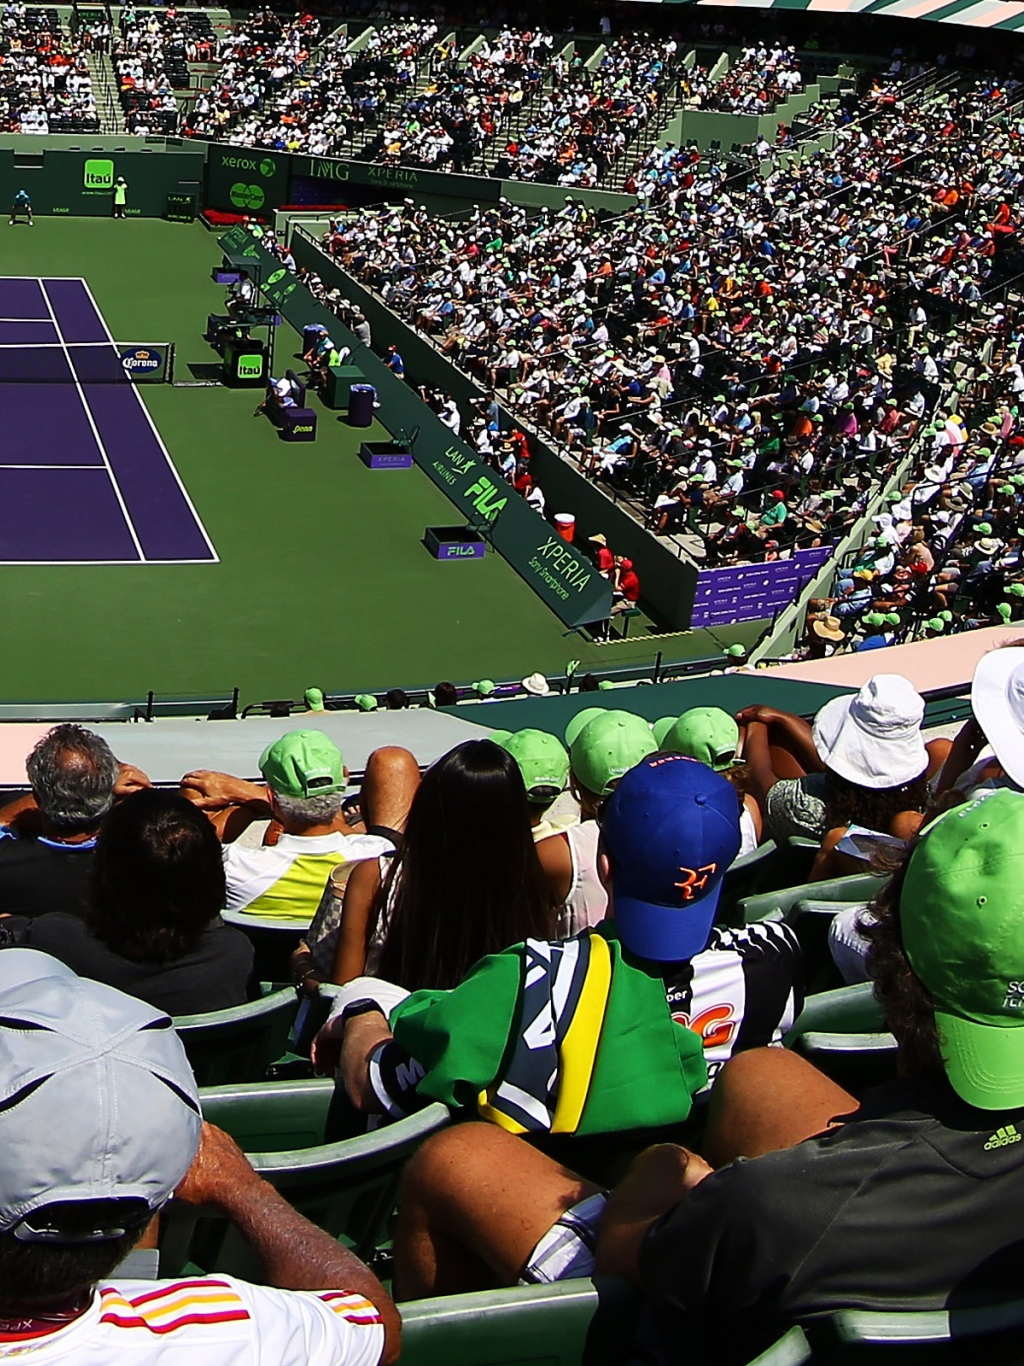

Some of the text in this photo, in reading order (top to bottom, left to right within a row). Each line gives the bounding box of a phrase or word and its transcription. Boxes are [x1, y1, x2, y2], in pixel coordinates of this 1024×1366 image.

[221, 155, 256, 170] xerox
[309, 159, 350, 181] IMG
[86, 172, 112, 184] Itaú
[367, 166, 418, 182] XPERIA
[122, 357, 158, 369] Corona
[239, 366, 261, 375] Itaú
[444, 446, 465, 466] LAN
[432, 460, 457, 486] AIRLINES
[463, 476, 508, 522] FILA
[447, 545, 476, 556] FILA
[537, 536, 592, 592] XPERIA
[528, 556, 570, 601] Sony Smartphone
[983, 1133, 1022, 1151] adidas
